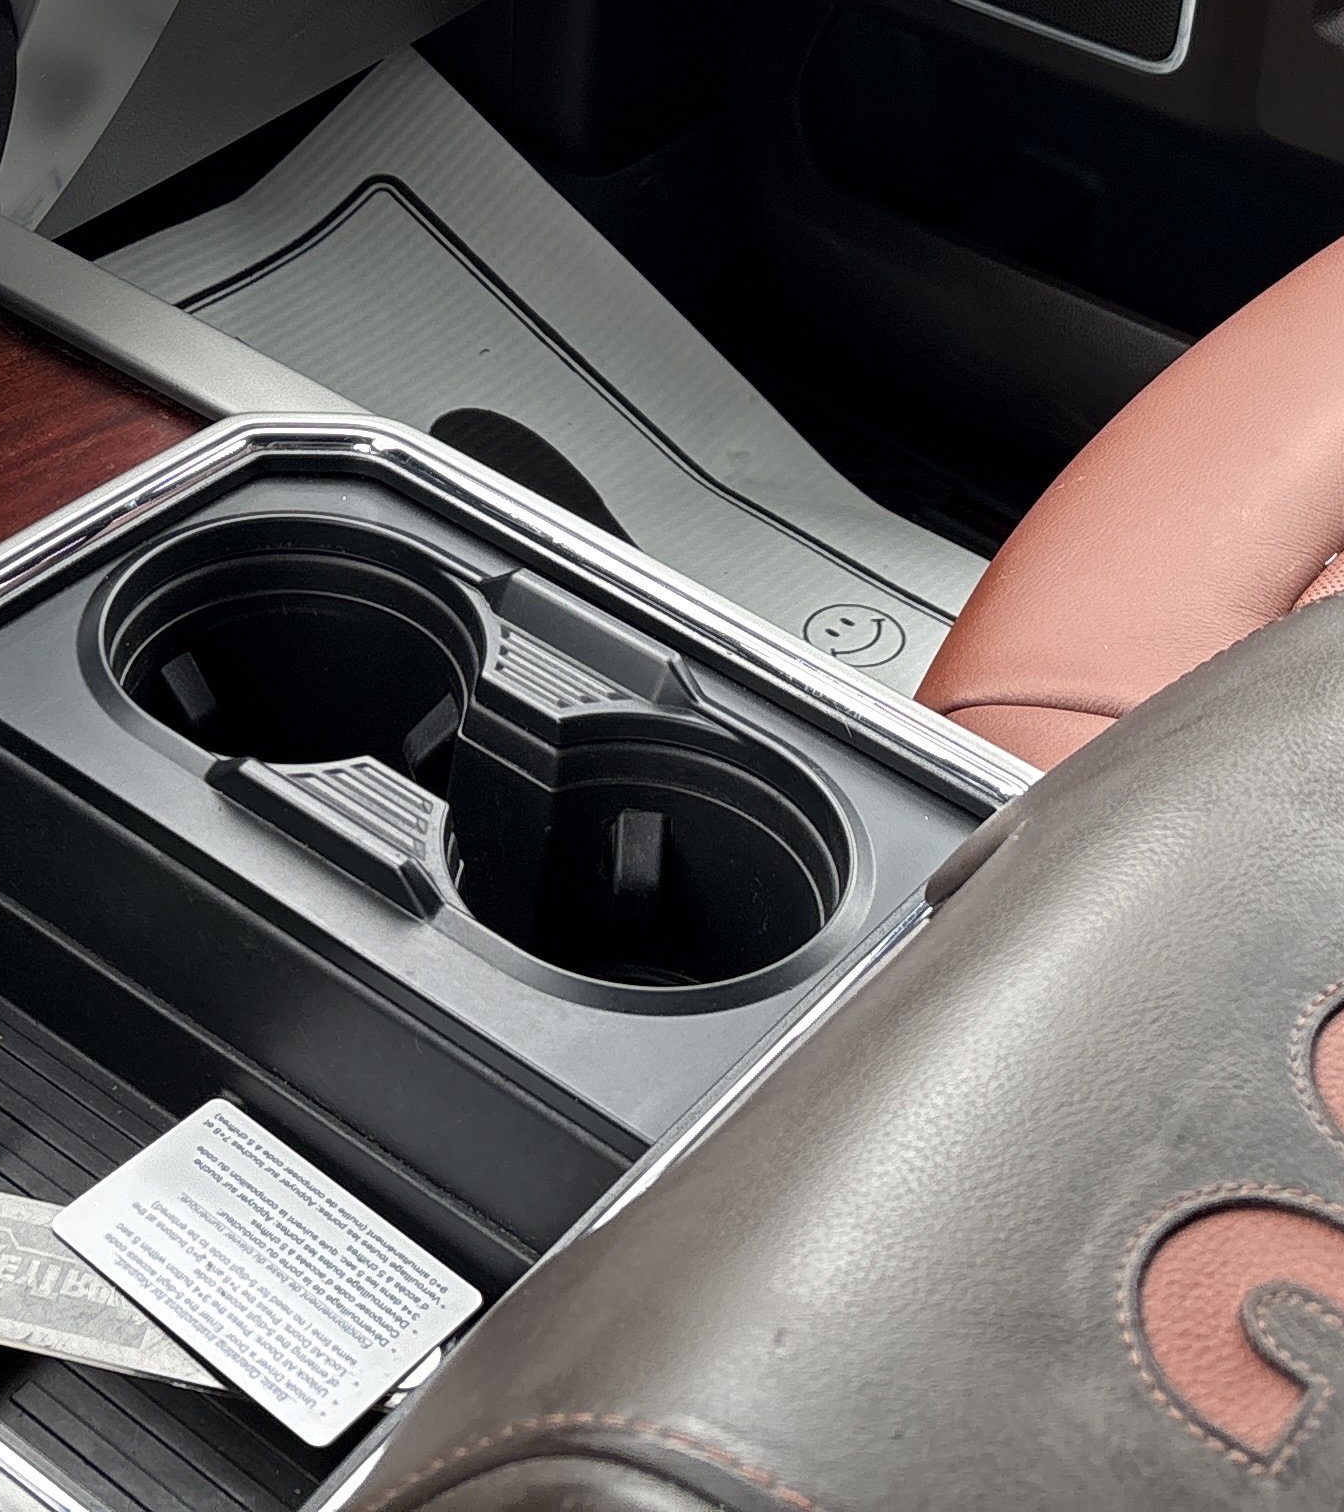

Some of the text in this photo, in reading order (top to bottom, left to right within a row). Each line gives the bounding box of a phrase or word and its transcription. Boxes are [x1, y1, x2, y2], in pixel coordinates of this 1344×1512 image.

[196, 1145, 218, 1162] code
[230, 1140, 264, 1167] touches
[262, 1149, 284, 1167] code
[193, 1158, 222, 1182] touche
[217, 1161, 230, 1171] du
[263, 1166, 280, 1178] sur
[221, 1181, 238, 1193] sur
[229, 1170, 278, 1209] composition
[278, 1178, 316, 1206] Appuyer
[282, 1167, 325, 1198] composer
[236, 1193, 274, 1221] Appuyer
[324, 1198, 338, 1208] de
[346, 1228, 361, 1241] les
[265, 1247, 279, 1258] du
[302, 1243, 318, 1257] les
[346, 1245, 378, 1270] chiffres
[360, 1239, 388, 1263] toutes
[278, 1258, 304, 1277] porte
[317, 1254, 345, 1278] toutes
[302, 1275, 312, 1286] la
[312, 1284, 325, 1295] de
[389, 1261, 440, 1304] Verrouillage
[333, 1284, 355, 1302] code
[379, 1286, 402, 1305] dans
[355, 1302, 399, 1338] Composer
